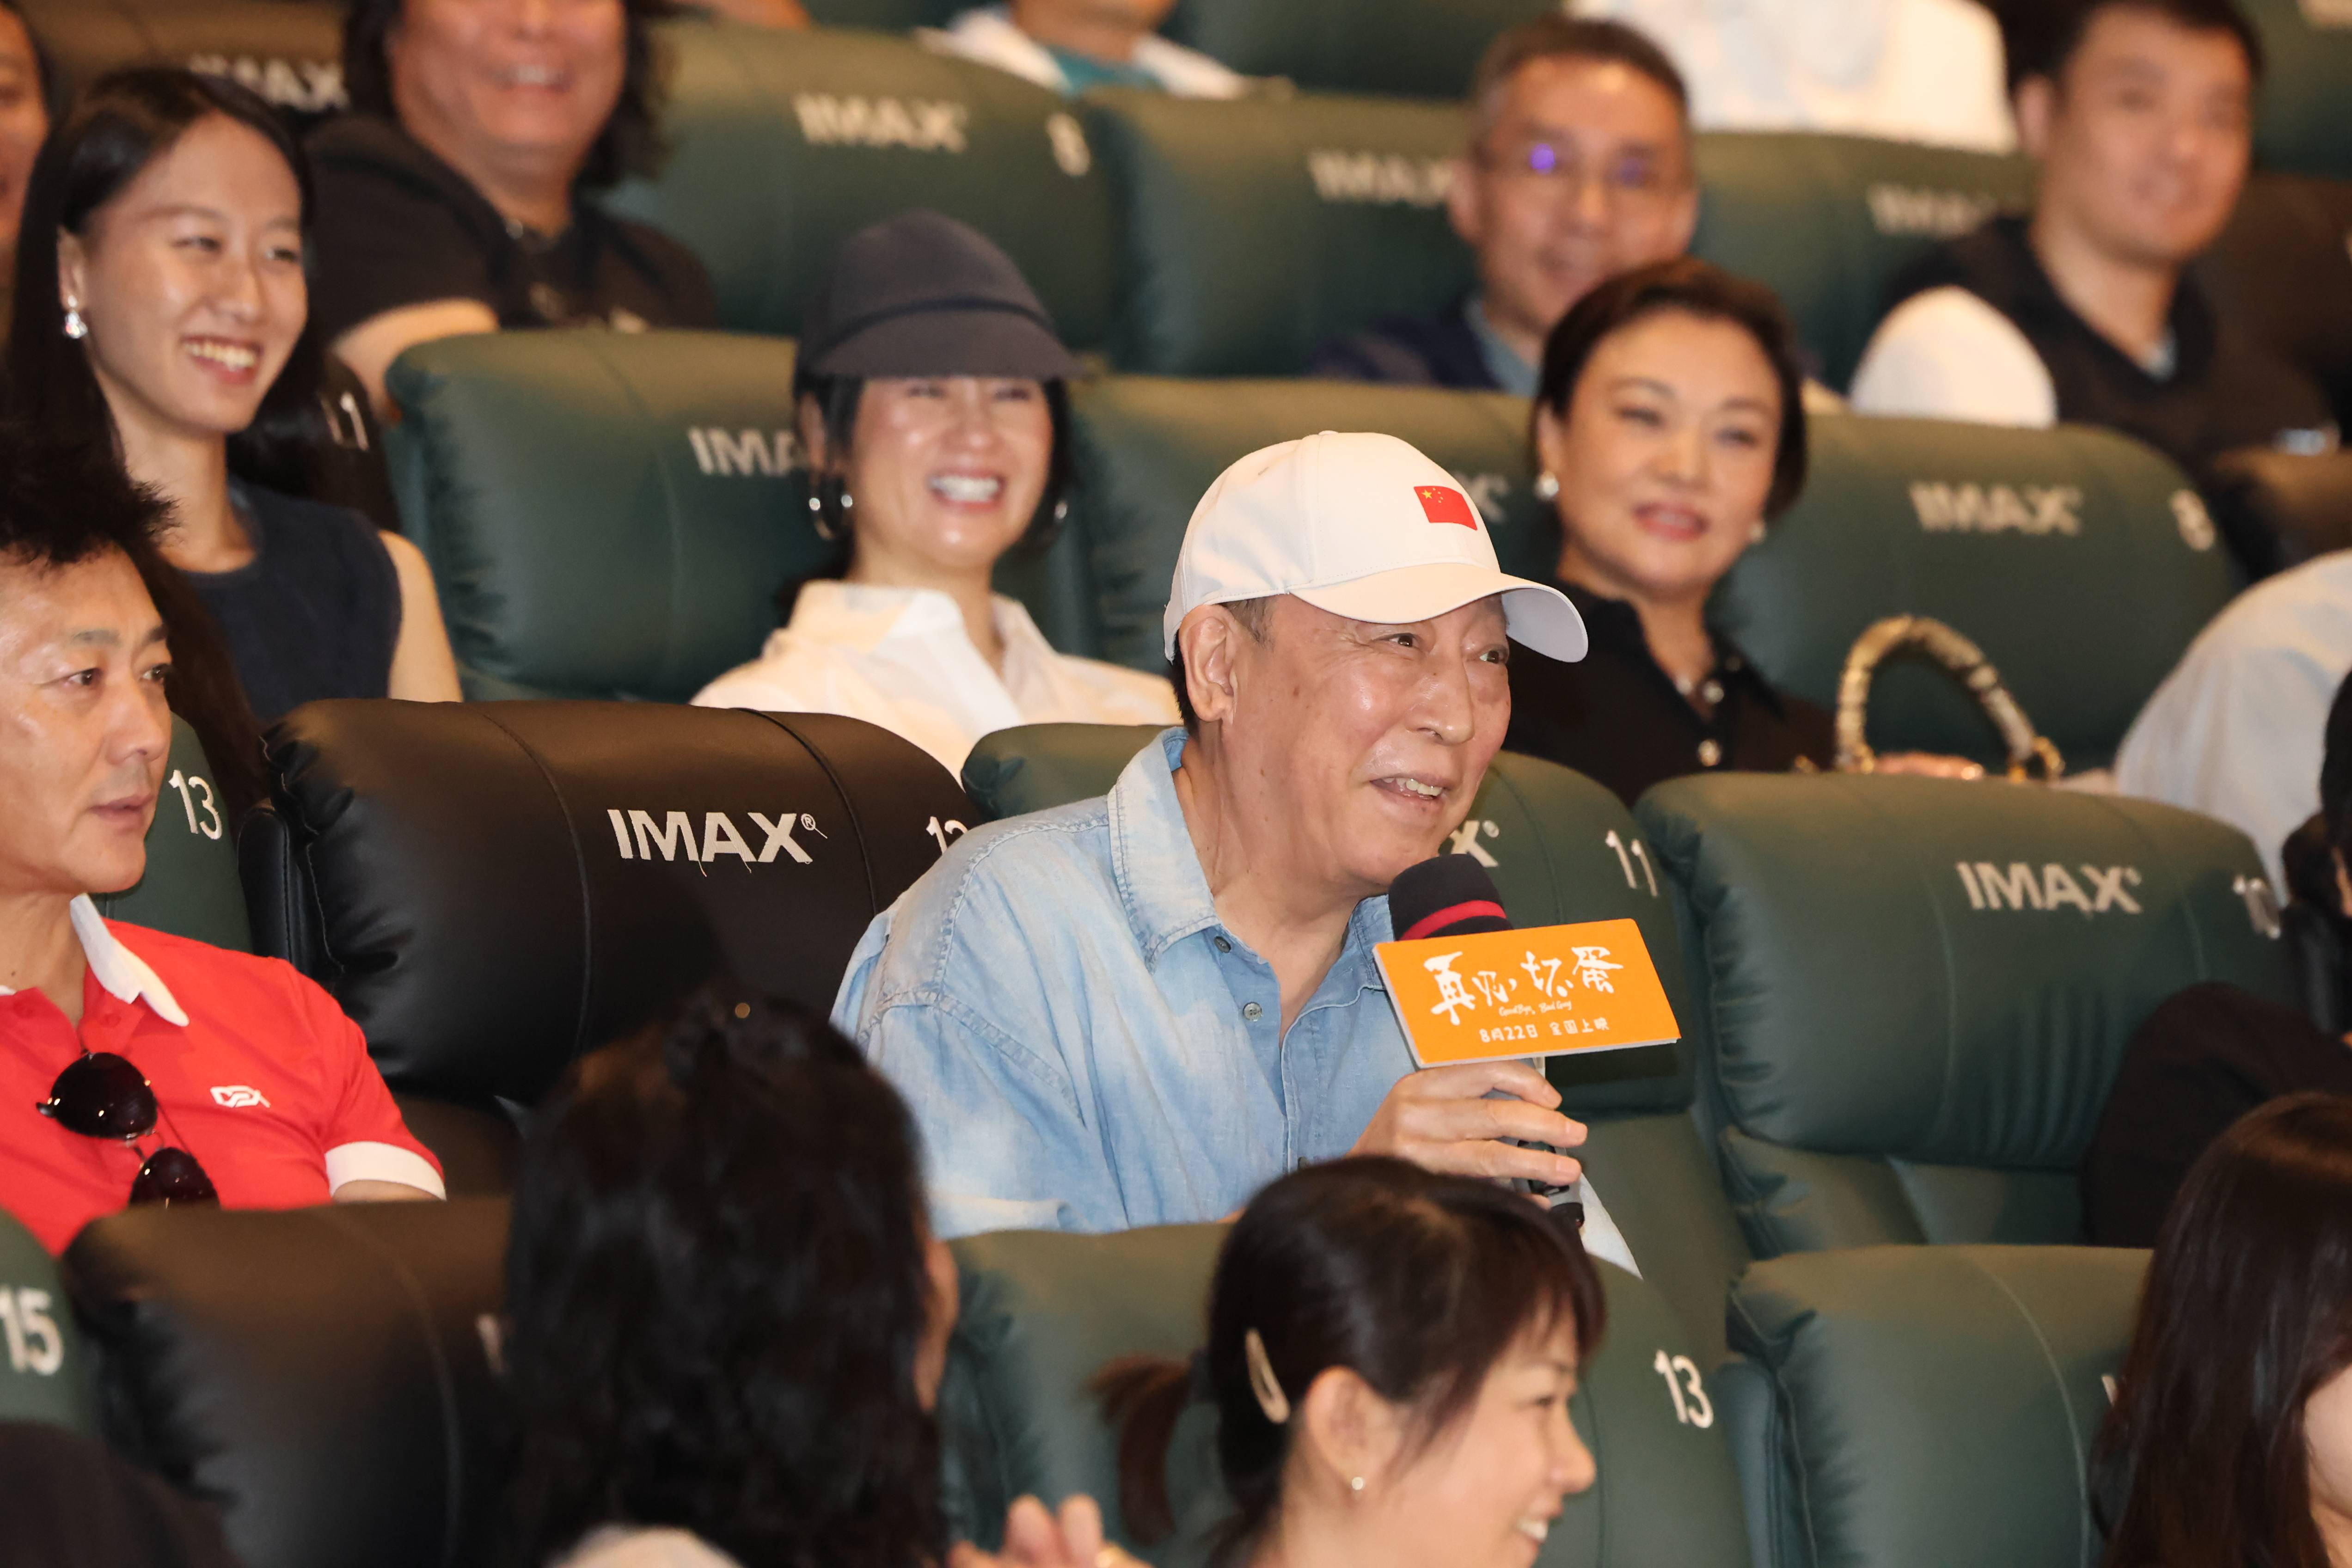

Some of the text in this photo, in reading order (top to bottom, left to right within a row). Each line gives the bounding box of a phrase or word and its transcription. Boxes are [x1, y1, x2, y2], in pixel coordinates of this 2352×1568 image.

[169, 770, 222, 840] 13
[1605, 830, 1658, 897] 11
[1479, 1017, 1609, 1043] 8月22日 全国上映
[1654, 1349, 1714, 1428] 13
